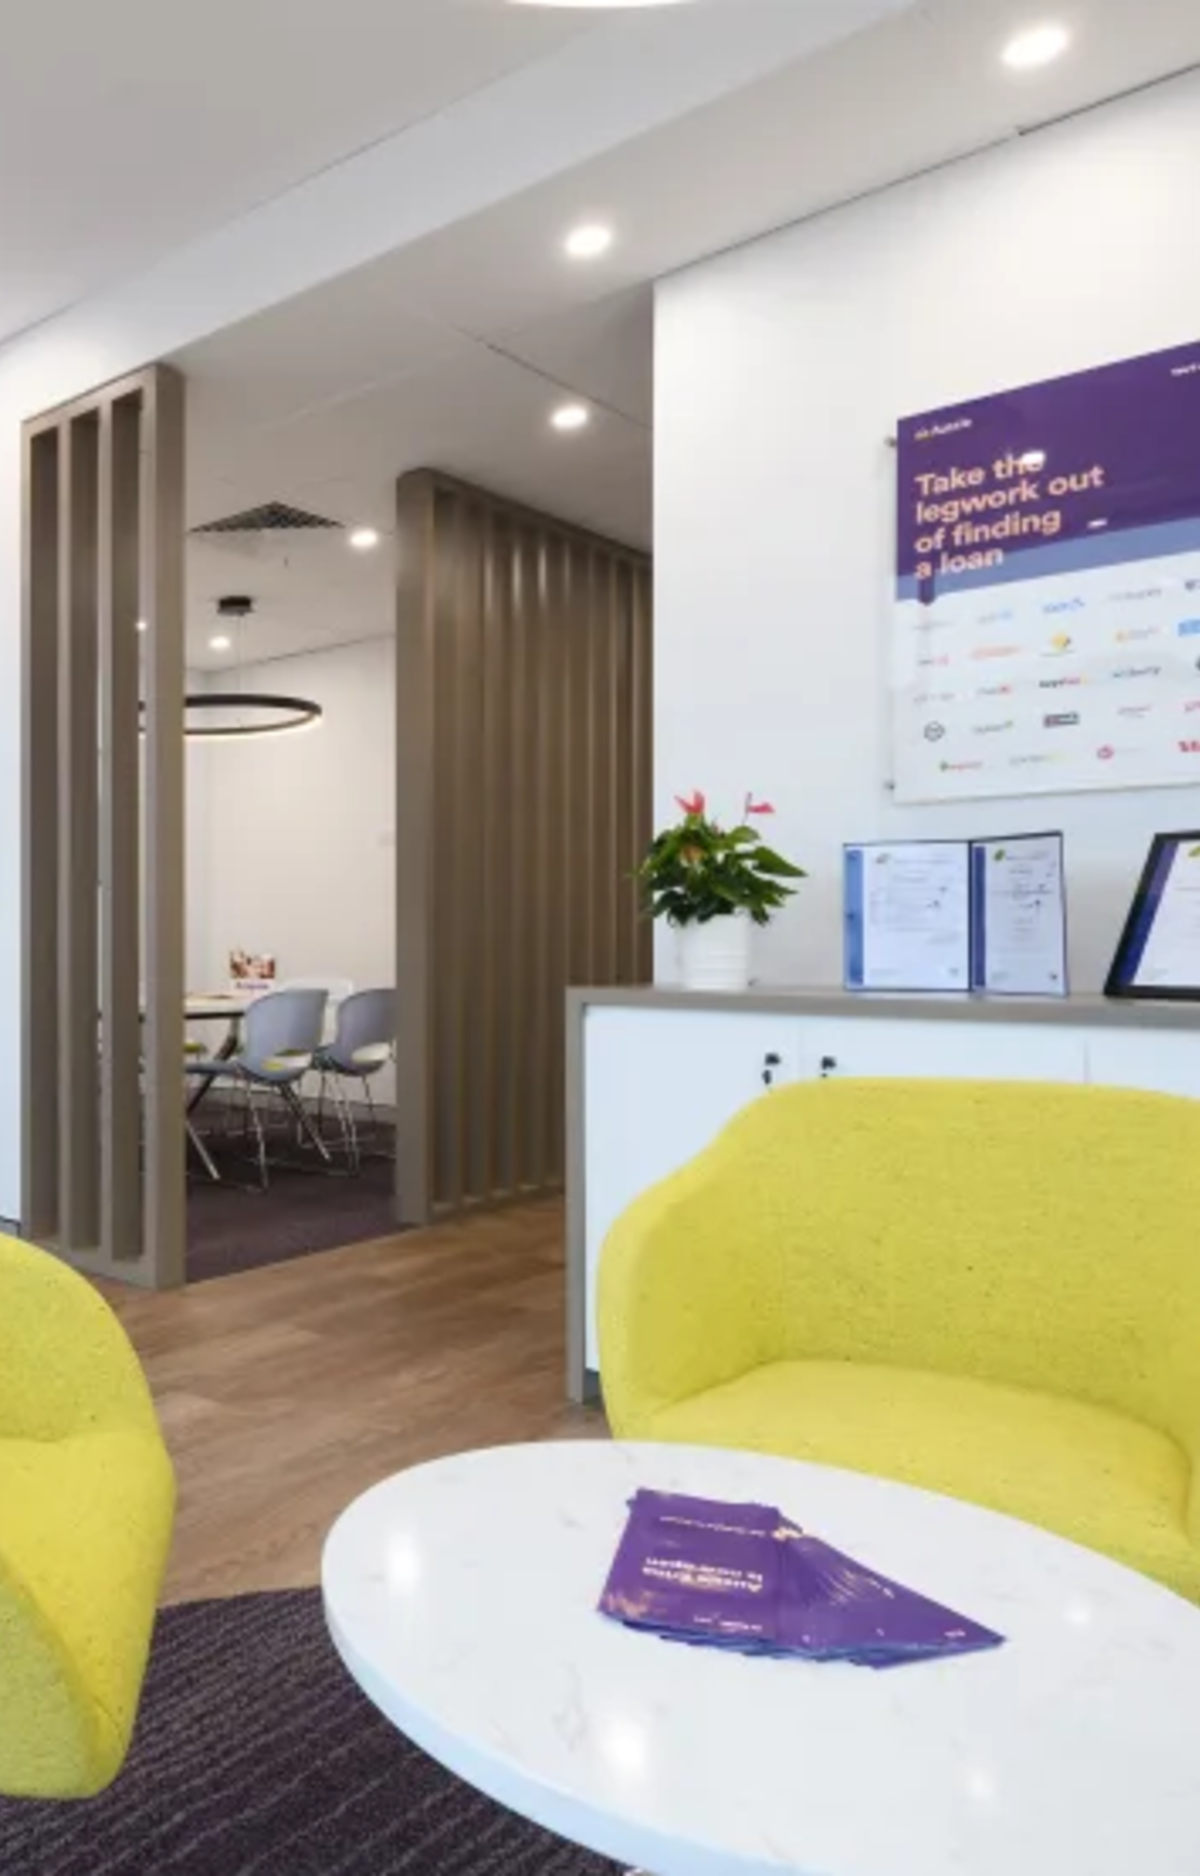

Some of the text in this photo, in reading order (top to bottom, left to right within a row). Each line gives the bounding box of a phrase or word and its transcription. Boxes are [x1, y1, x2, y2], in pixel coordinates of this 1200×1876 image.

[914, 452, 1044, 496] Take the
[916, 465, 1104, 525] legwork out
[915, 510, 1061, 553] of finding
[914, 547, 1004, 579] a loan
